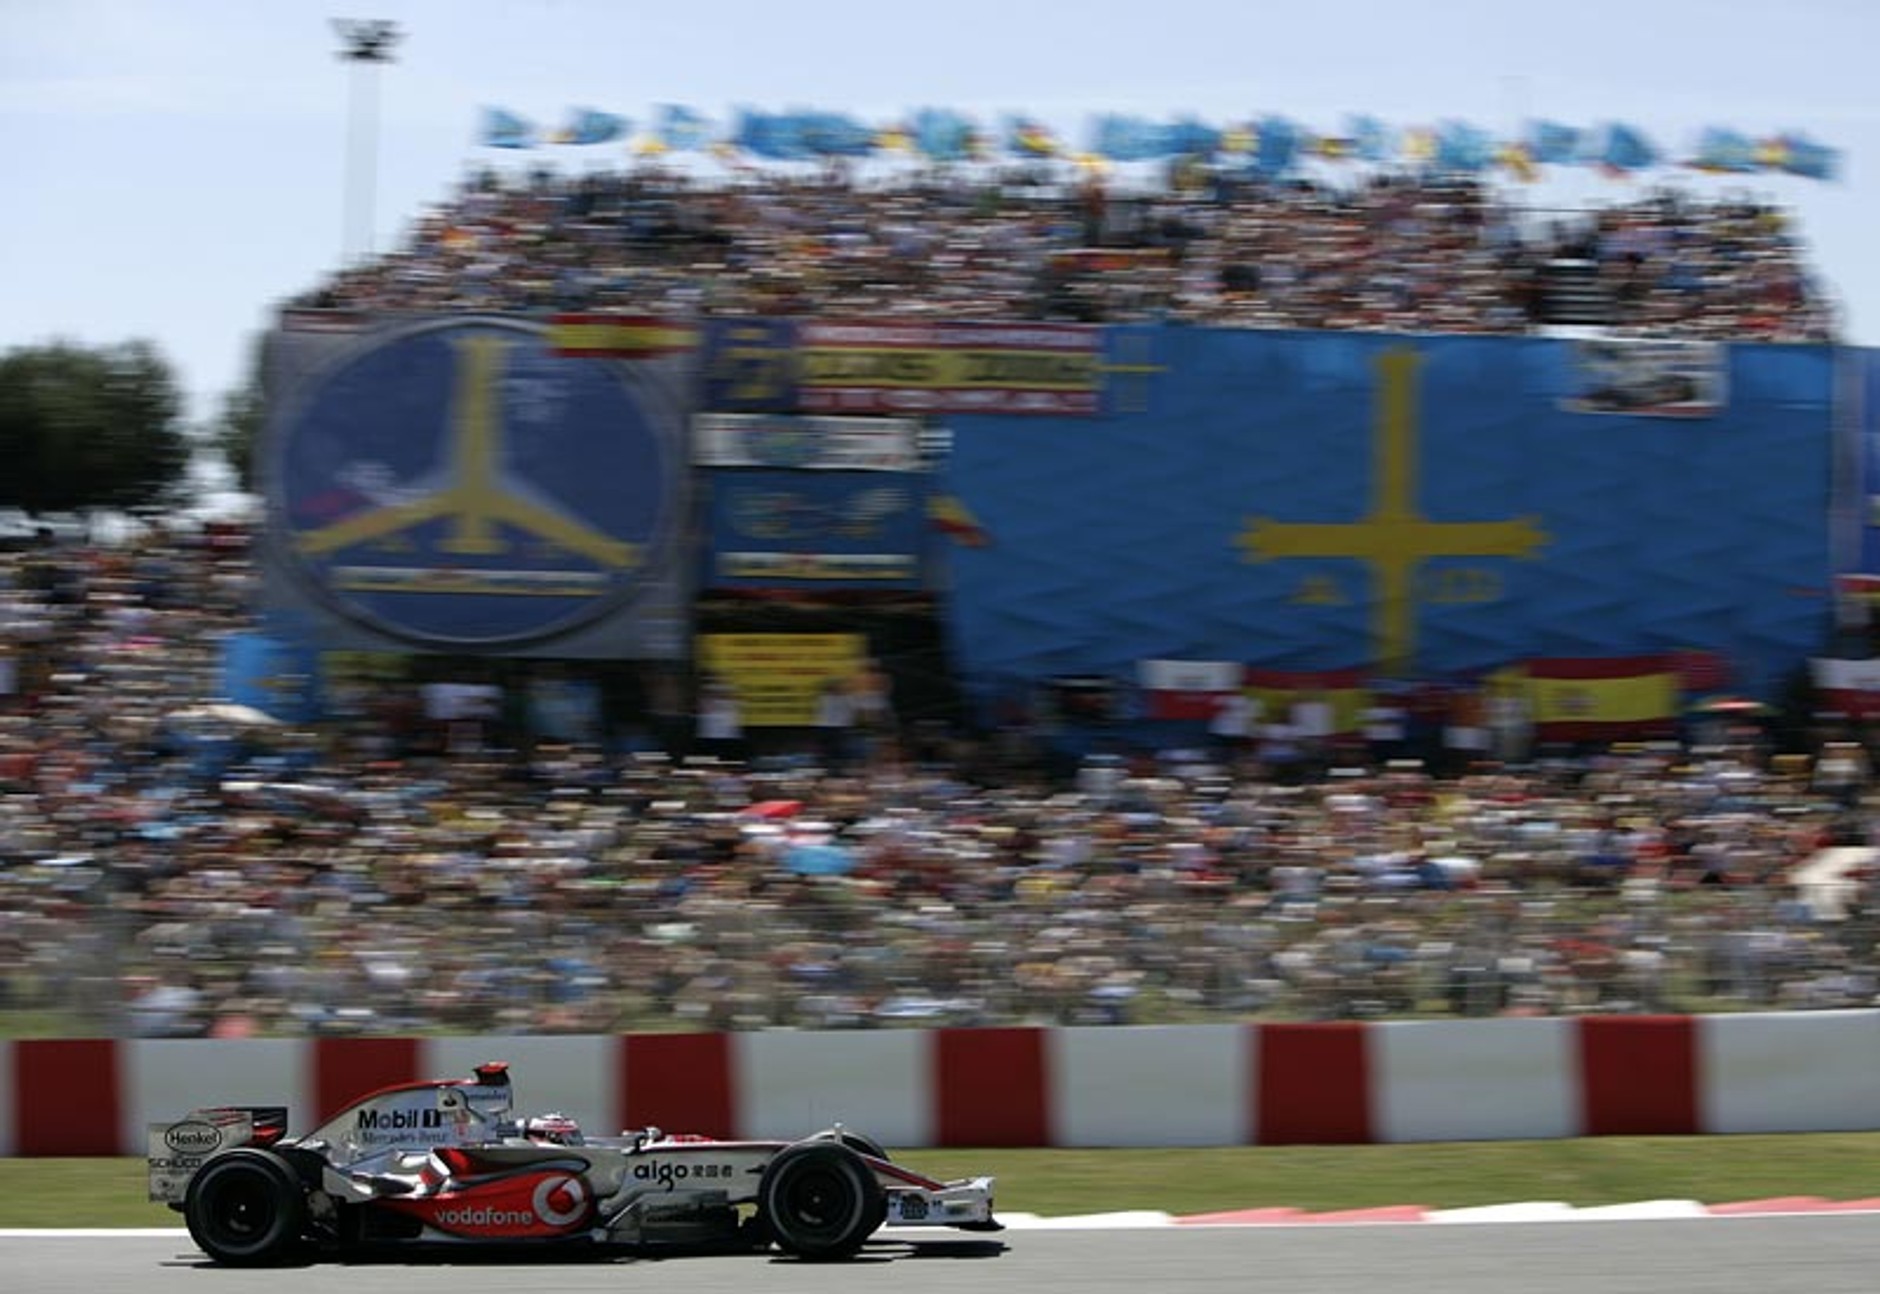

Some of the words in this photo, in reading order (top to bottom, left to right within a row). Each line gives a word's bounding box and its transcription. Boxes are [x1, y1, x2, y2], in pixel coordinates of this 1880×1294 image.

[358, 1108, 417, 1129] Mobil
[168, 1131, 218, 1145] Henkel
[633, 1160, 688, 1192] aigo
[434, 1206, 533, 1225] vodafone
